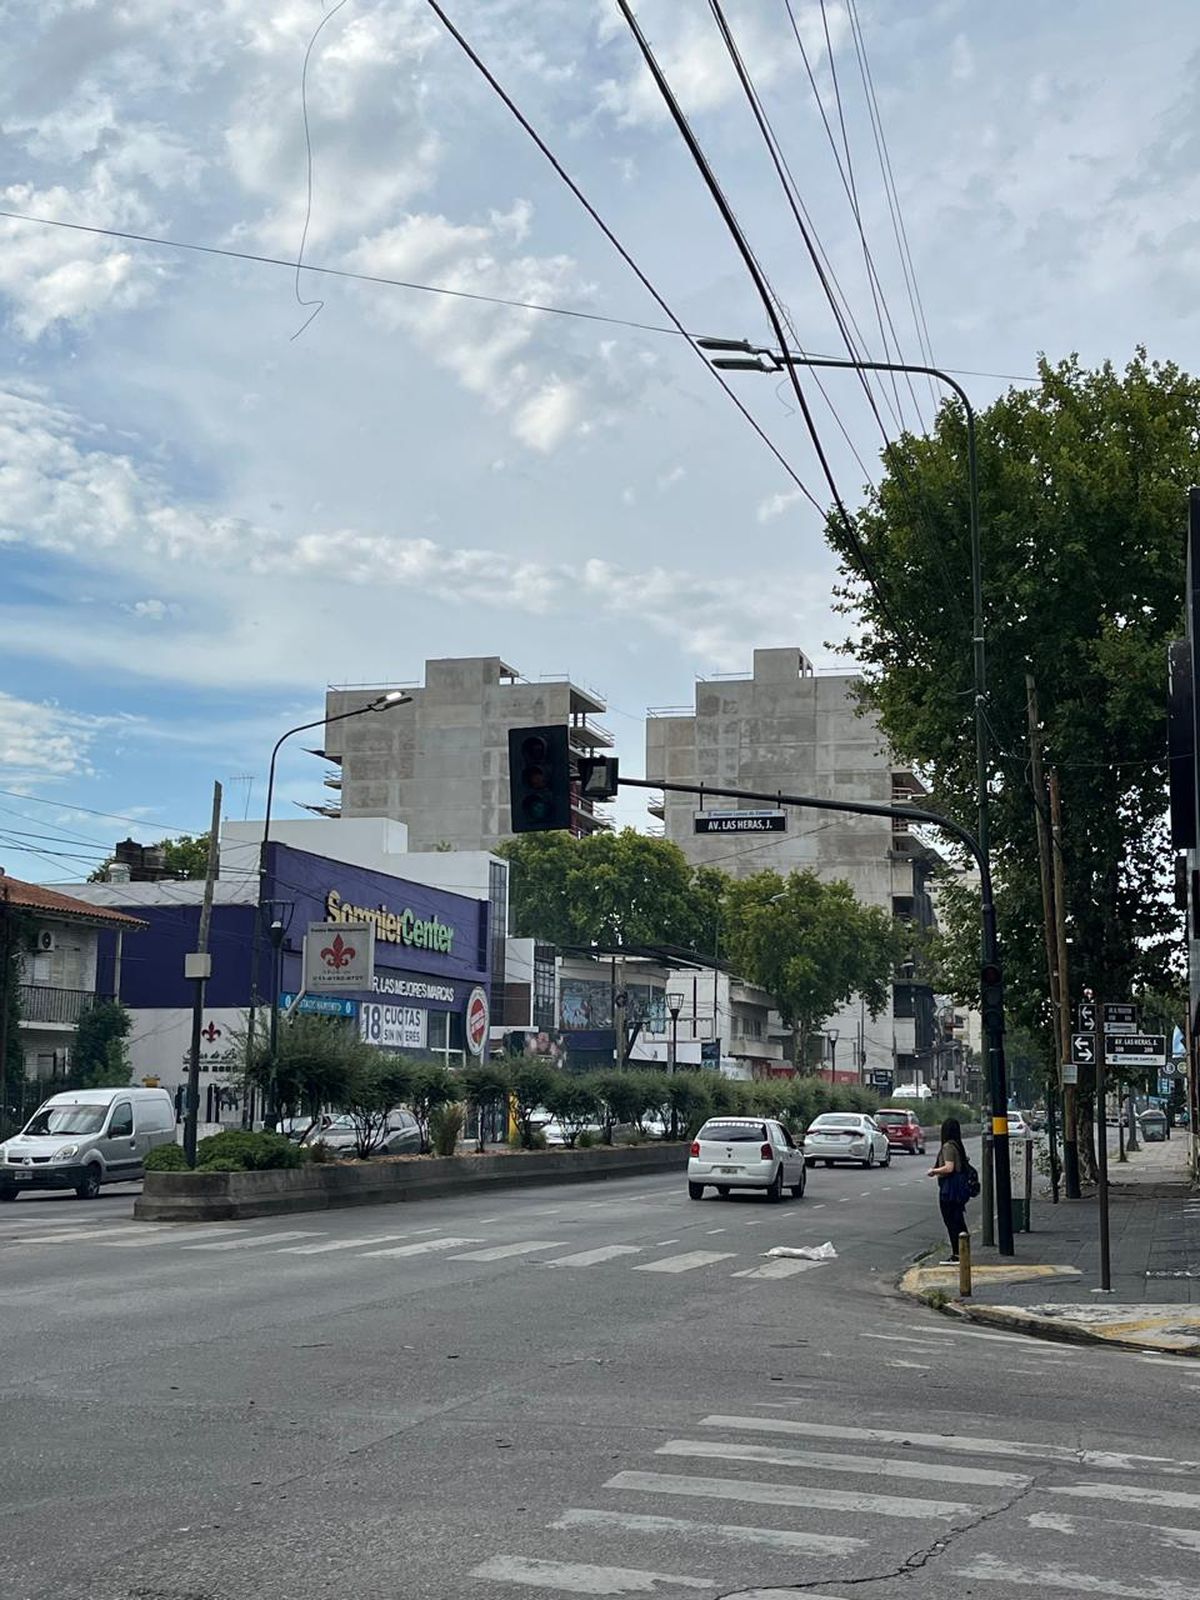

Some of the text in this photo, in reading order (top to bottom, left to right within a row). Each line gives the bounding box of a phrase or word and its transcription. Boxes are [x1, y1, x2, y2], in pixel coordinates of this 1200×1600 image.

[708, 819, 773, 831] AV. LAS HERAS, J.
[380, 977, 395, 994] LAS
[427, 985, 455, 1002] MARCAS
[363, 1004, 381, 1041] 18
[385, 1007, 421, 1027] CUOTAS
[384, 1028, 396, 1041] SIN
